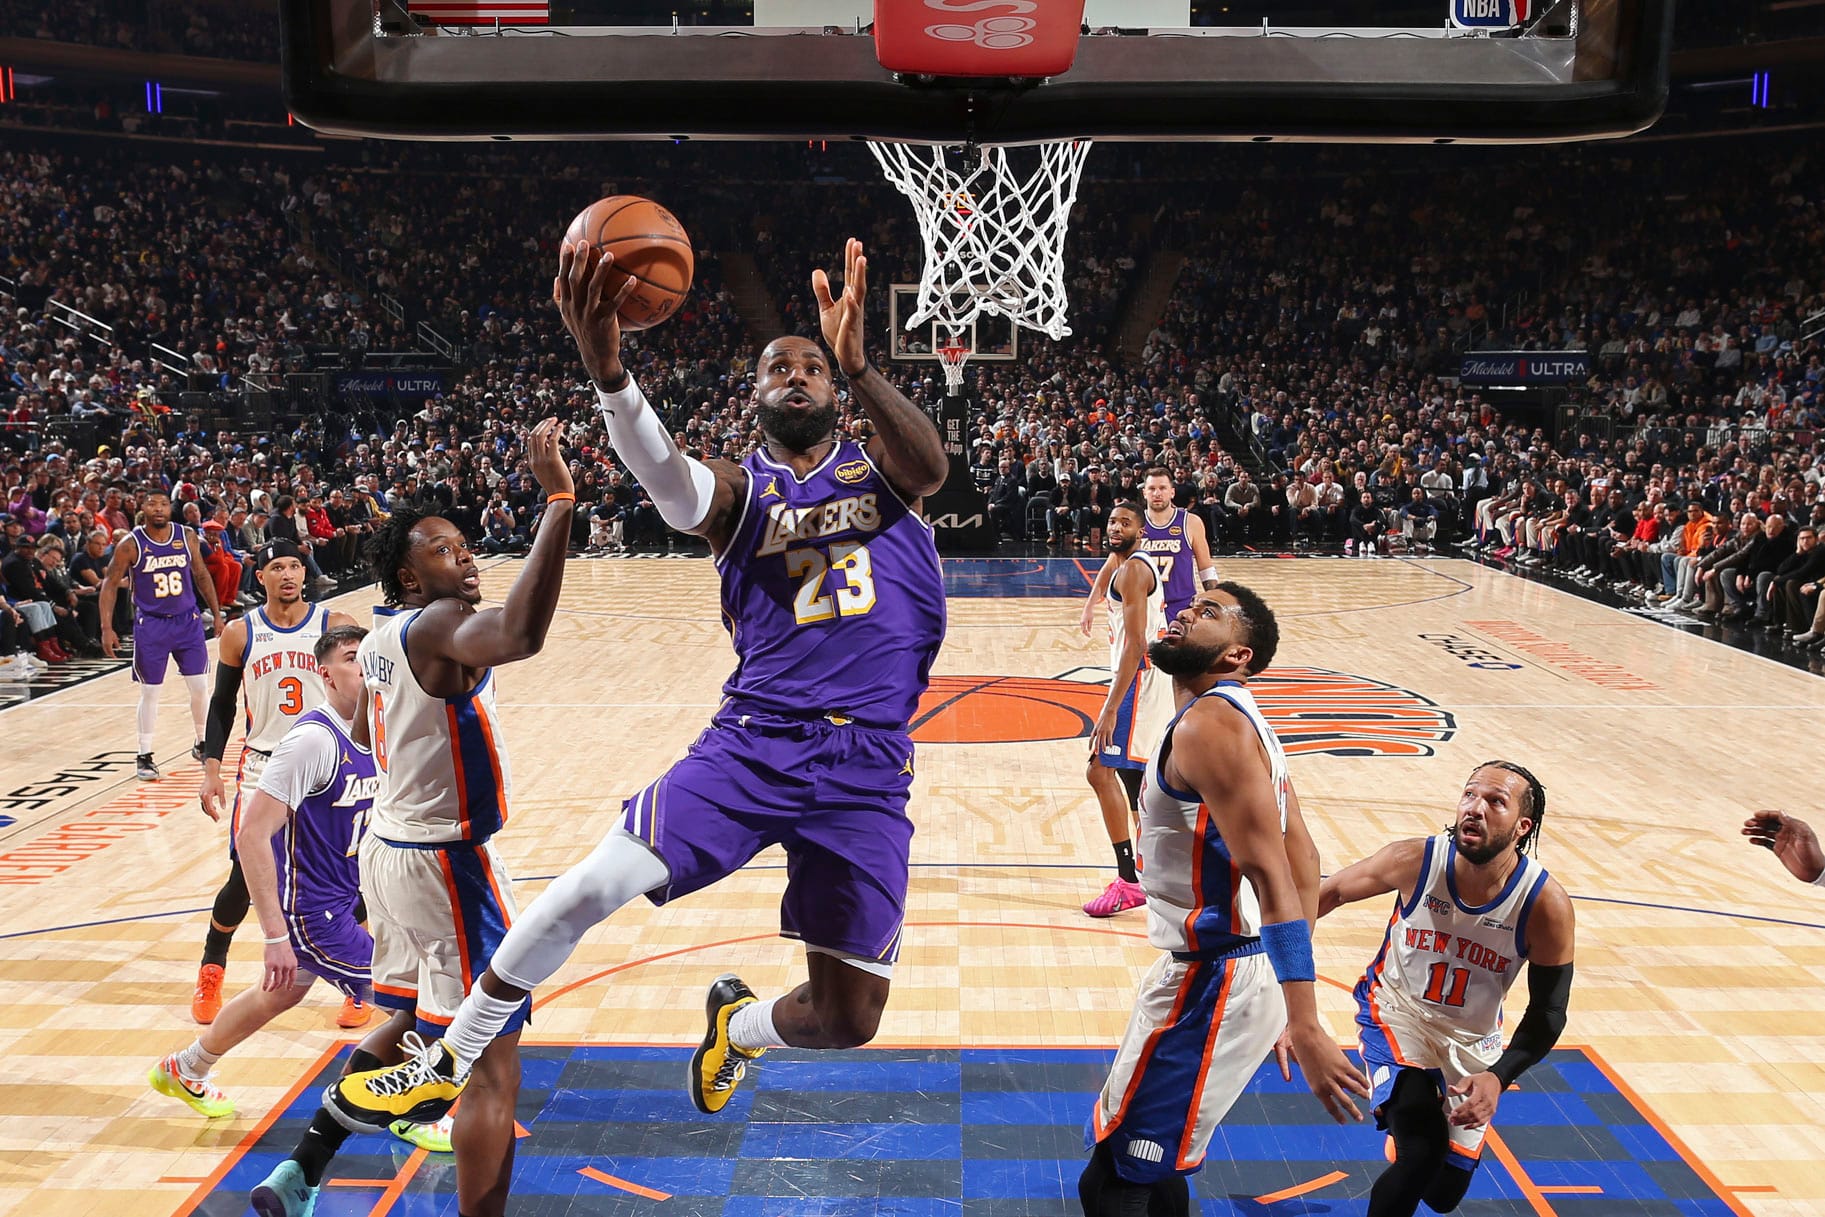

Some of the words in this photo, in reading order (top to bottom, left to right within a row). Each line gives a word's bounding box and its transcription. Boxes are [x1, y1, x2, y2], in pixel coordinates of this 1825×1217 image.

[1463, 0, 1500, 18] NBA
[1460, 360, 1515, 377] Michelob
[1531, 362, 1586, 376] ULTRA
[397, 380, 440, 391] ULTRA
[946, 419, 960, 430] GET
[948, 430, 960, 441] THE
[950, 441, 963, 455] App
[837, 465, 868, 477] bibigo
[756, 493, 882, 558] LAKERS
[142, 554, 187, 573] LAKERS
[153, 571, 183, 598] 36
[784, 540, 877, 625] 23
[1417, 633, 1504, 661] CHASE
[252, 652, 283, 680] NEW
[278, 677, 304, 716] 3
[331, 773, 380, 807] LAKE
[1423, 894, 1451, 916] NYC
[1405, 927, 1452, 954] NEW
[1456, 936, 1512, 975] YORK
[1423, 961, 1471, 1008] 11
